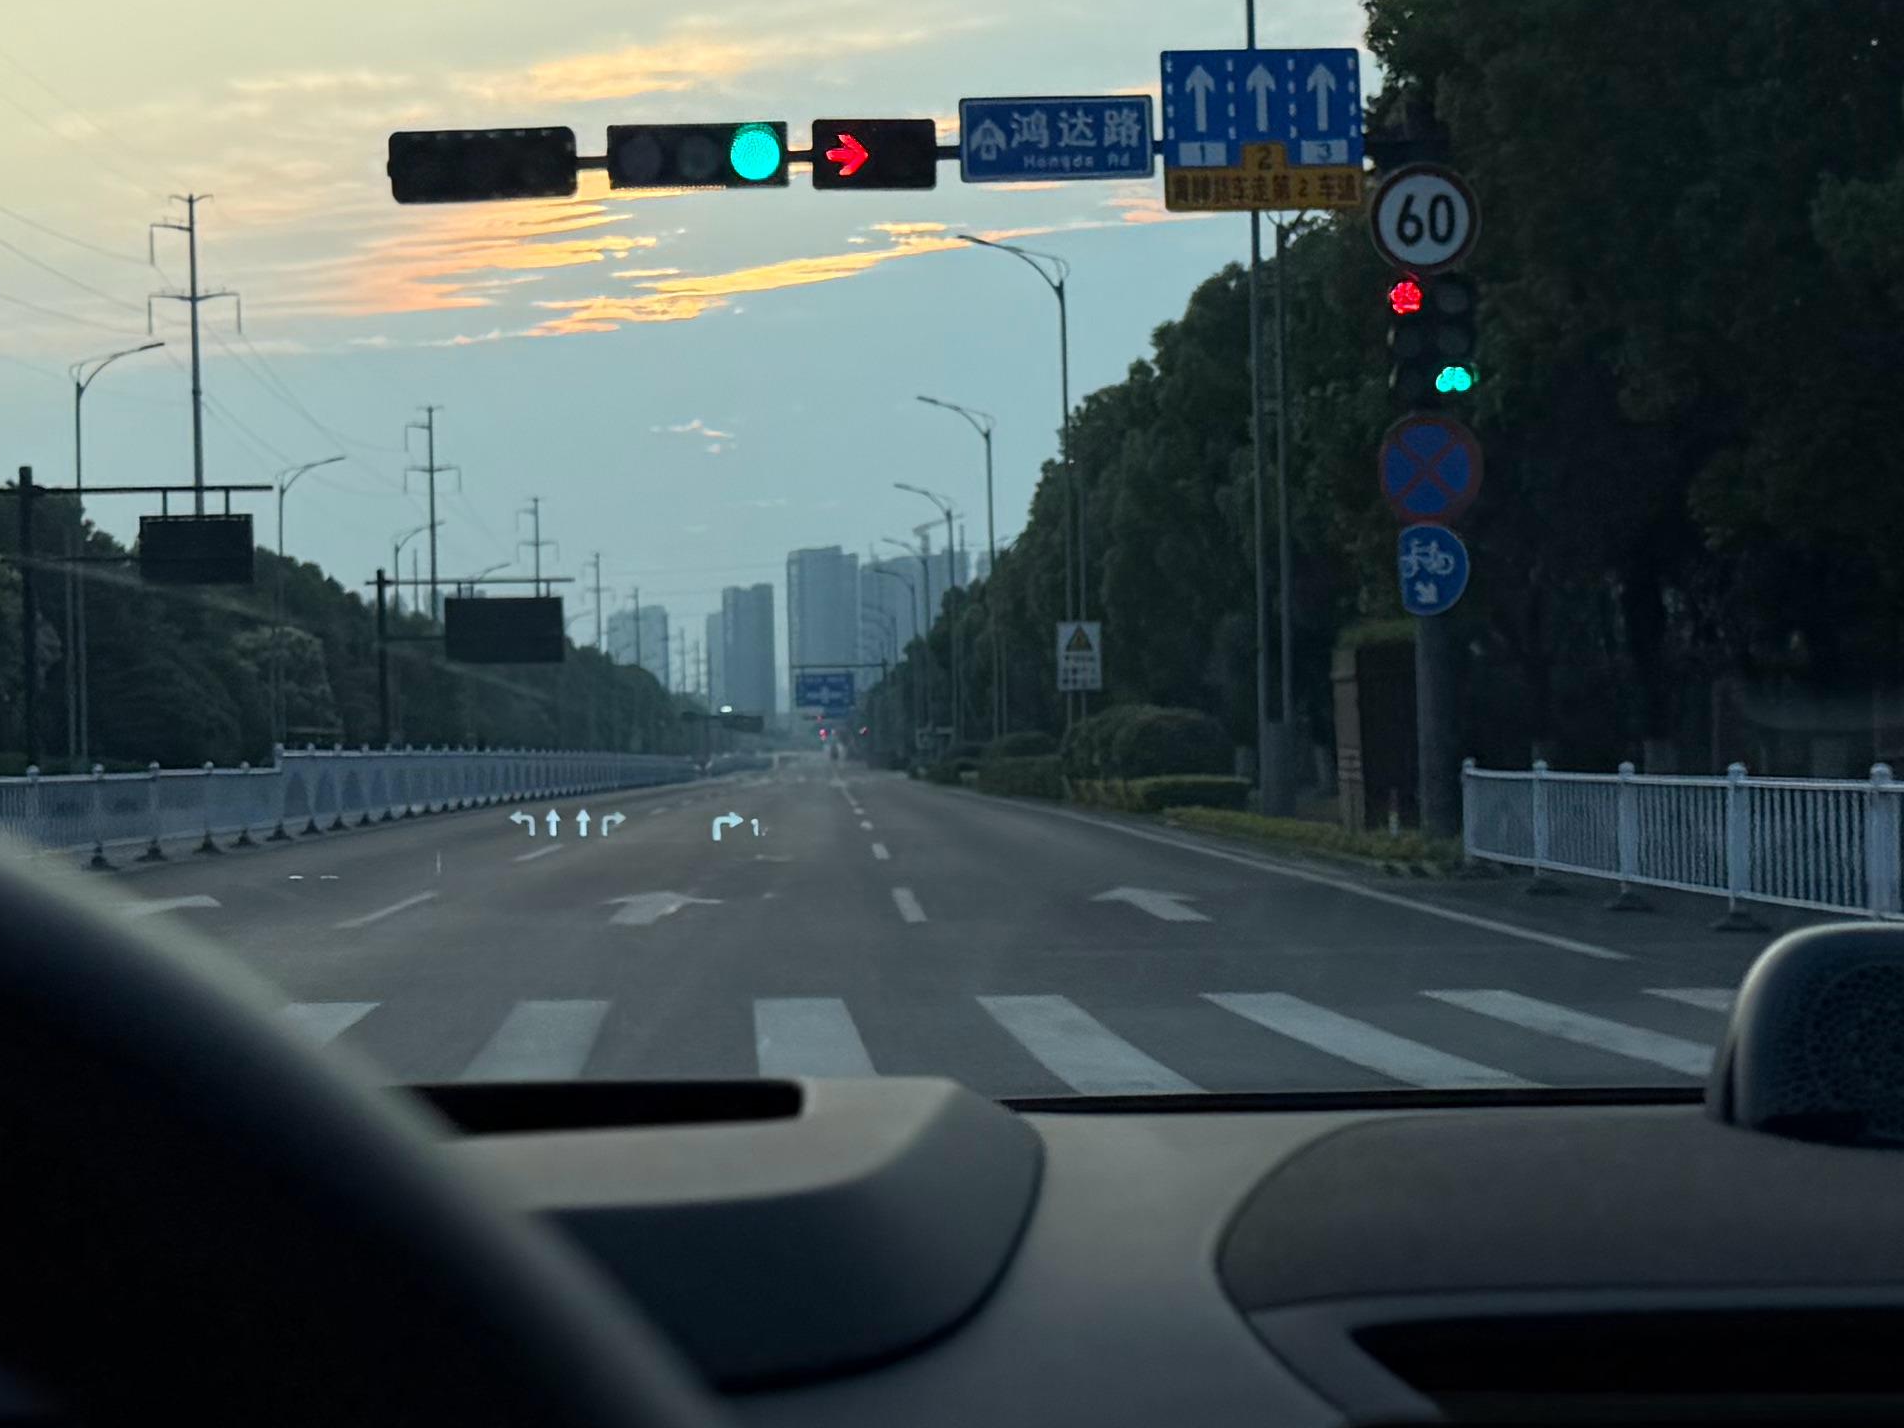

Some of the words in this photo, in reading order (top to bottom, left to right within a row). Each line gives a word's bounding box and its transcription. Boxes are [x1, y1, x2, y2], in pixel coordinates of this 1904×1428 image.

[1010, 107, 1142, 149] 鸿达路
[1257, 146, 1273, 170] 2
[1317, 143, 1333, 160] 3
[1396, 193, 1456, 247] 60
